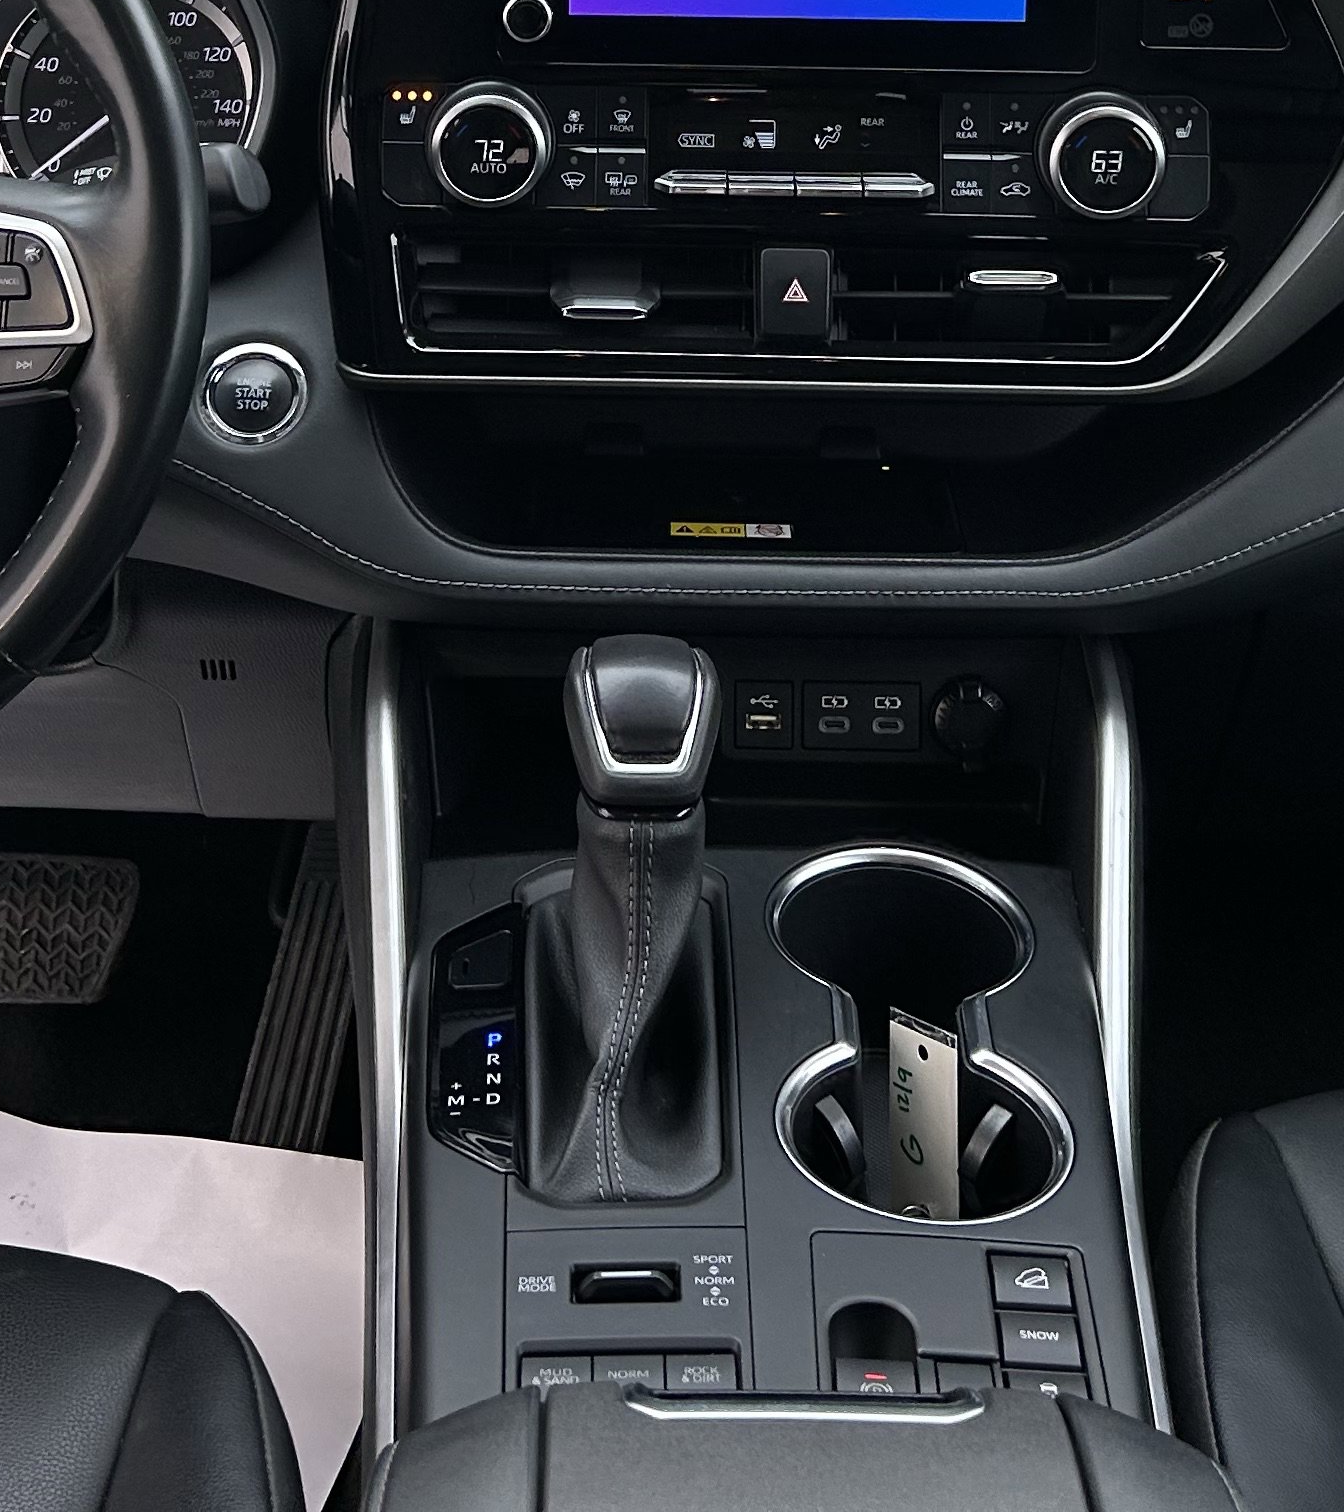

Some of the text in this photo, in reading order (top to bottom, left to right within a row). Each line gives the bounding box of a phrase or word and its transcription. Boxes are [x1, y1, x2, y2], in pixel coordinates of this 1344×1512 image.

[168, 11, 198, 27] 100
[202, 47, 232, 62] 120
[34, 56, 60, 72] 40
[213, 98, 244, 114] 140
[27, 108, 52, 123] 20
[217, 118, 241, 128] MPH
[860, 117, 885, 127] REAR
[563, 123, 586, 134] OFF
[609, 124, 635, 133] FRONT
[956, 131, 978, 139] REAR
[681, 135, 713, 147] SYNC
[474, 139, 504, 162] 72
[1091, 150, 1124, 173] 63
[470, 162, 507, 174] AUTO
[956, 180, 978, 188] REAR
[1094, 173, 1119, 185] A/C
[609, 187, 632, 196] REAR
[950, 188, 984, 197] CLIMATE
[235, 387, 273, 399] START
[236, 399, 269, 411] STOP
[487, 1032, 503, 1047] P
[486, 1052, 501, 1066] R
[486, 1072, 502, 1085] N
[447, 1094, 465, 1107] M
[485, 1092, 501, 1105] D
[692, 1254, 734, 1264] SPORT
[518, 1275, 555, 1285] DRIVE
[694, 1275, 735, 1286] NORM
[517, 1283, 556, 1293] MODE
[702, 1296, 730, 1307] ECO
[1019, 1329, 1060, 1341] SNOW
[539, 1367, 573, 1377] MUD
[607, 1369, 650, 1379] NORM
[683, 1365, 719, 1376] ROCK
[543, 1374, 580, 1385] SAND
[693, 1373, 723, 1384] DIRT
